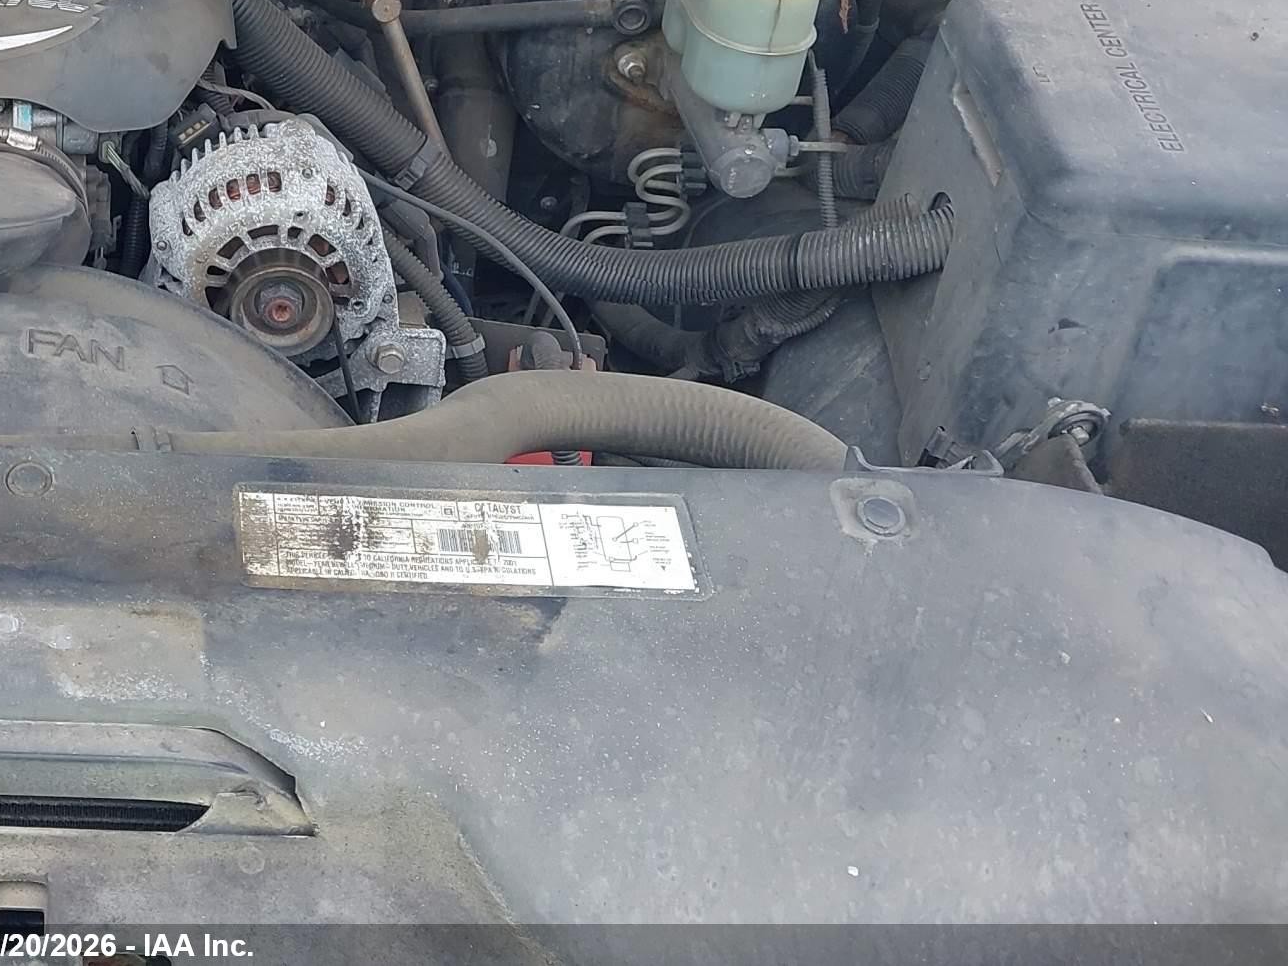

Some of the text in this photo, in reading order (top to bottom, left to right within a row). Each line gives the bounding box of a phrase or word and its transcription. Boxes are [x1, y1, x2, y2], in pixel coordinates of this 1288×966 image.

[1080, 3, 1184, 152] ELECTRICAL CENTER
[27, 328, 125, 370] FAN
